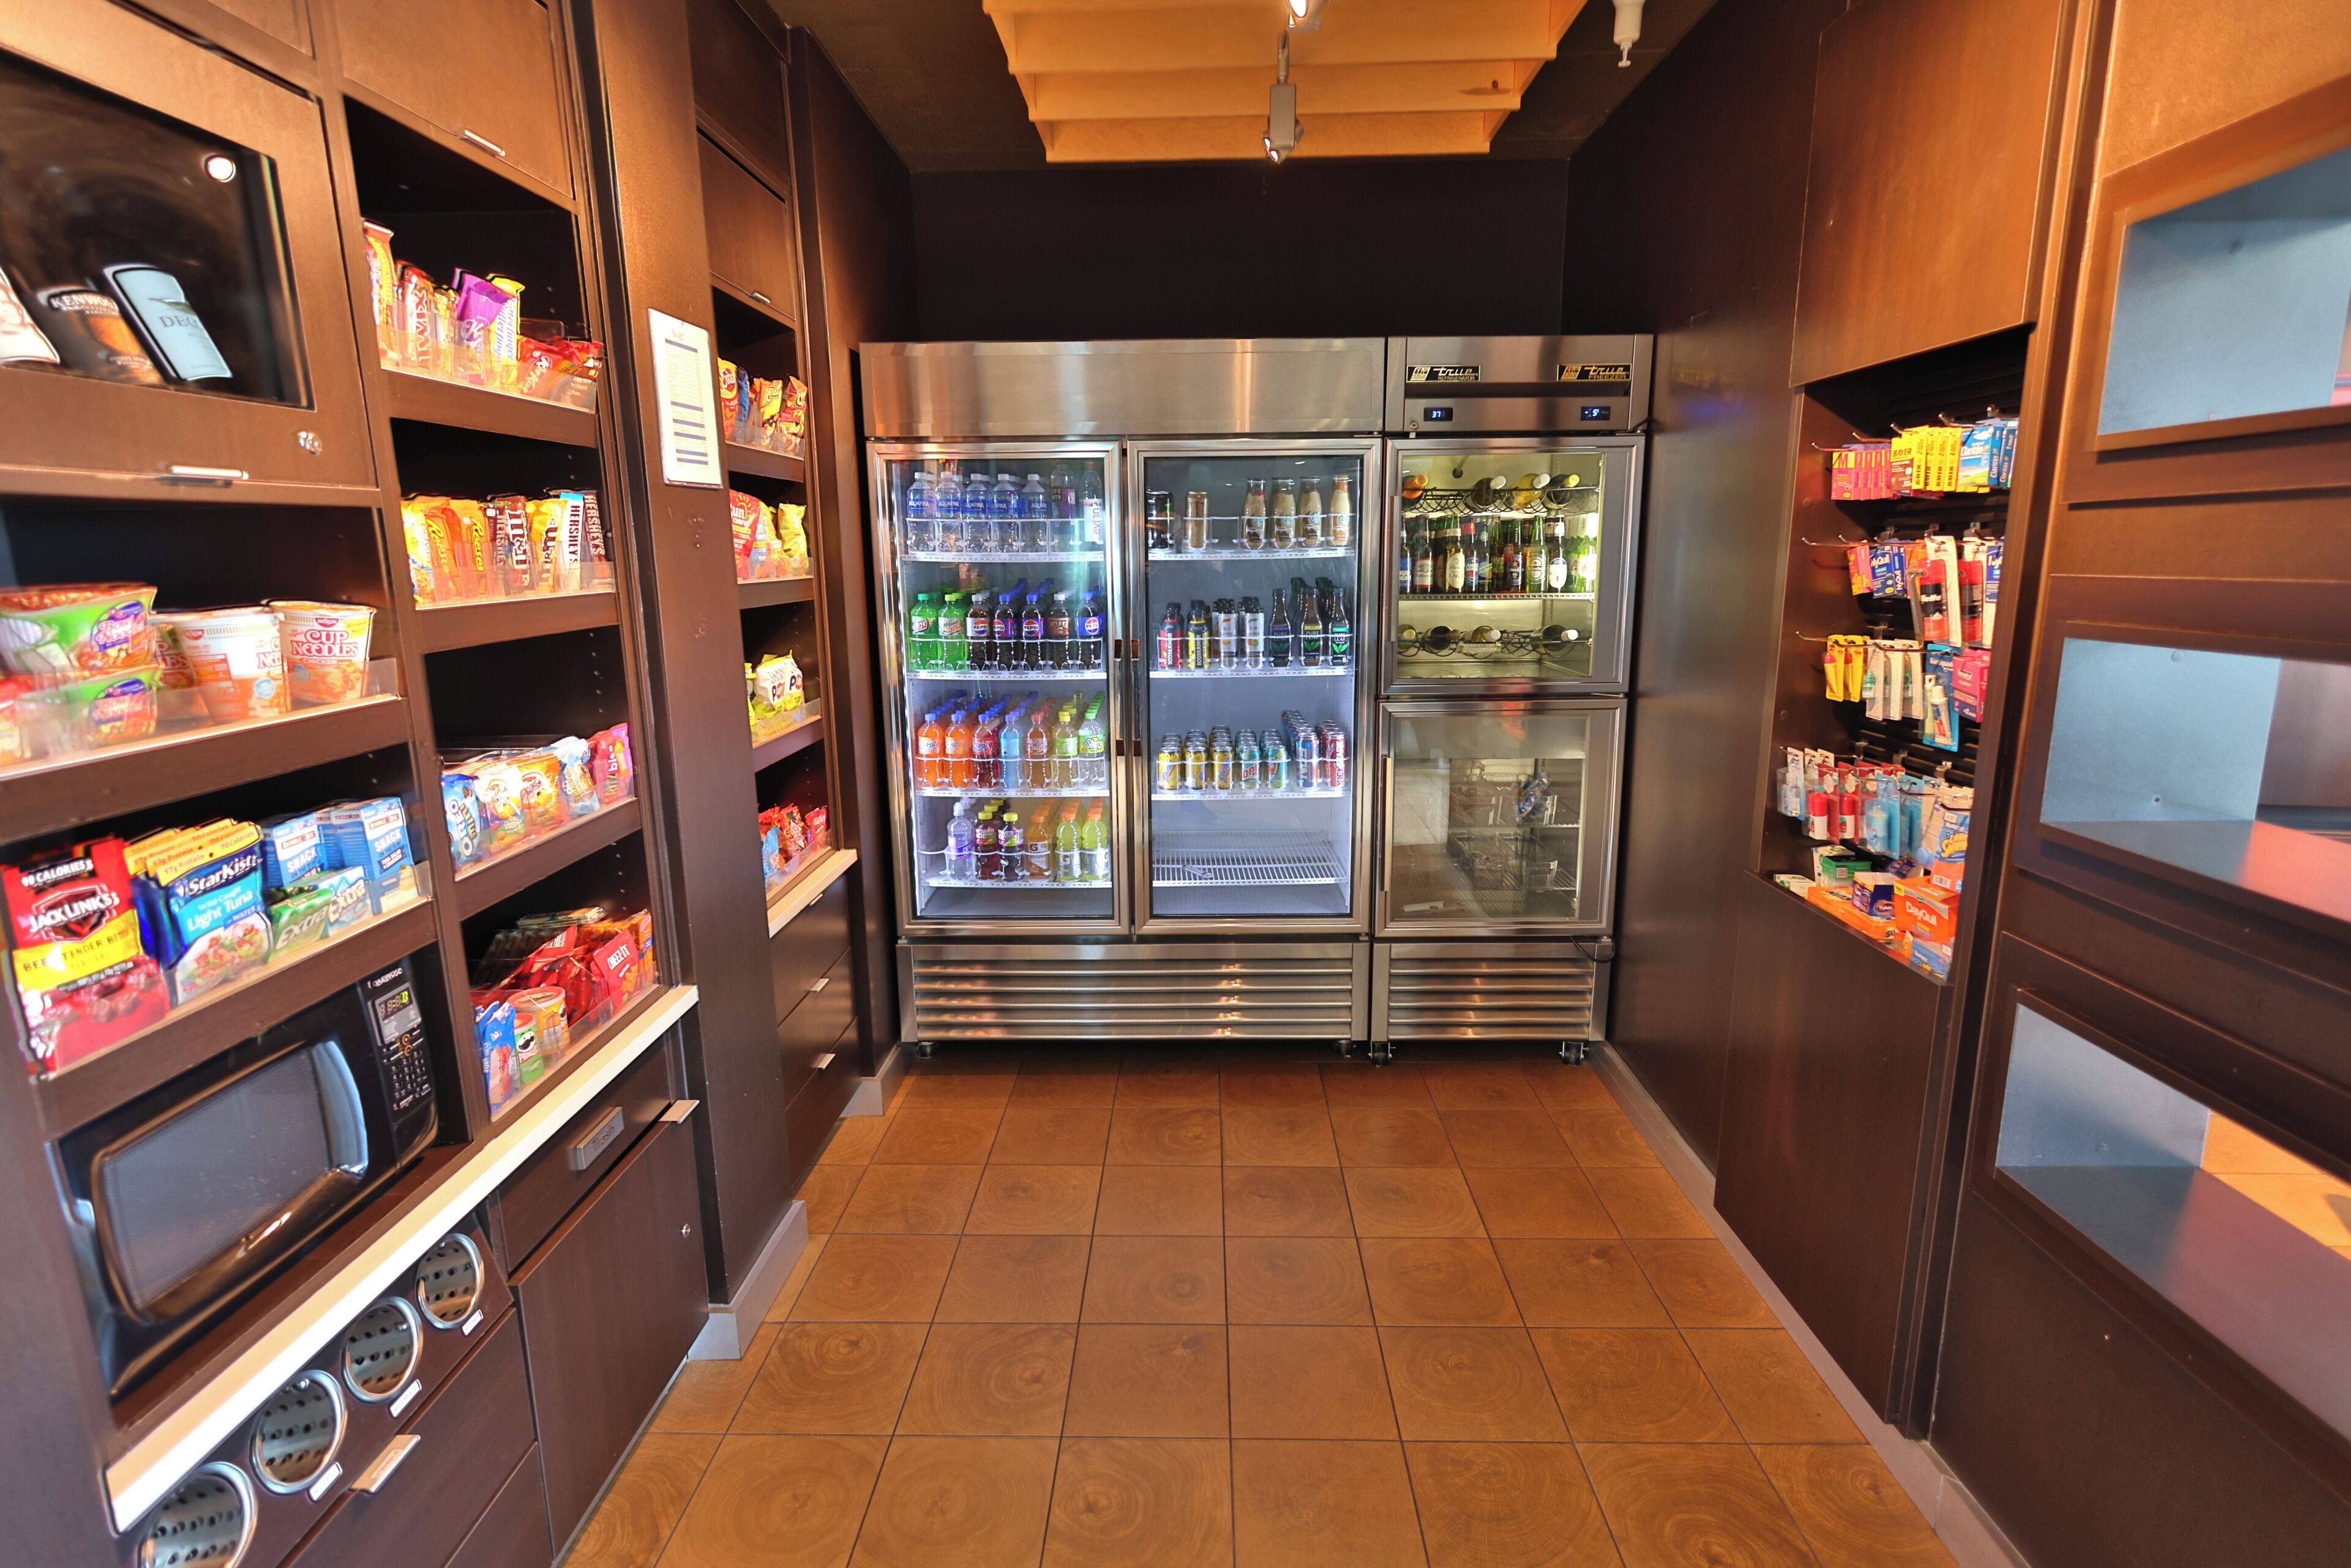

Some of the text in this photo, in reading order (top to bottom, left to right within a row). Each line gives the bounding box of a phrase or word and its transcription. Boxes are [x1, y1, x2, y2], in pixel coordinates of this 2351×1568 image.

[413, 288, 428, 362] TWIX
[1433, 366, 1475, 376] true
[1584, 366, 1626, 375] true
[1892, 448, 1911, 457] BAYER
[584, 495, 606, 556] HERSHEY'S
[1092, 507, 1101, 535] evian
[290, 640, 358, 658] NOODLES
[304, 629, 349, 644] CUP
[450, 799, 474, 857] OREO
[164, 865, 179, 875] 17g
[179, 854, 205, 868] Protein
[230, 831, 254, 849] Calories
[374, 829, 403, 853] SNACK
[287, 849, 318, 872] SNACK
[21, 874, 36, 887] 90
[187, 855, 258, 895] StarKist
[187, 890, 253, 932] Light Tuna
[198, 899, 219, 910] Wild
[232, 906, 256, 921] WATER
[1905, 901, 1937, 926] DayQuil
[29, 907, 64, 933] JACK
[276, 905, 329, 949] Extra
[23, 957, 48, 972] BEE
[62, 939, 103, 961] TENDER
[607, 943, 631, 970] CHEEZ-IT
